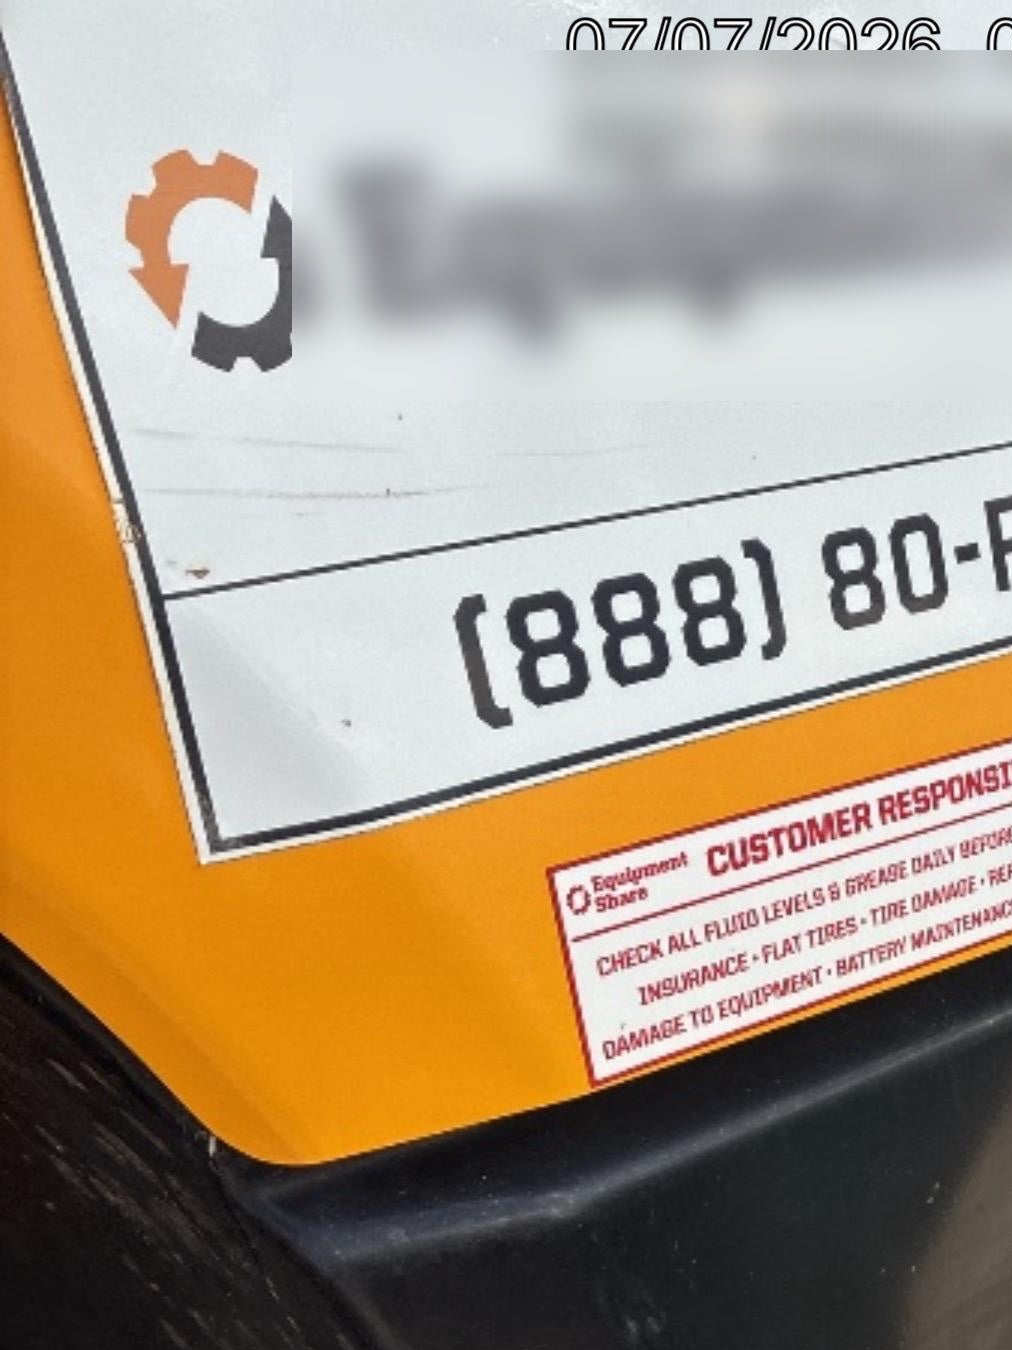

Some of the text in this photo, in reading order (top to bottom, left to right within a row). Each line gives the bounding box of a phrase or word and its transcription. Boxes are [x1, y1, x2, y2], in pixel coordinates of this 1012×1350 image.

[454, 538, 788, 729] (888)
[591, 852, 688, 892] Equipment
[594, 888, 649, 913] Share
[706, 801, 873, 877] CUSTOMER
[596, 939, 664, 976] CHECK
[668, 928, 702, 955] ALL
[703, 908, 760, 942] FLUID
[761, 886, 826, 924] LEVELS
[845, 861, 909, 897] GREASE
[911, 846, 957, 874] DAILY
[637, 952, 750, 1006] INSURANCE
[761, 936, 802, 964] FLAT
[805, 918, 858, 946] TIRES
[869, 900, 909, 928] TIRE
[911, 876, 977, 912] DAMAGE
[602, 1014, 687, 1060] DAMAGE
[689, 1004, 714, 1028] TO
[717, 966, 823, 1021] EQUIPMENT
[836, 937, 907, 976] BATTERY
